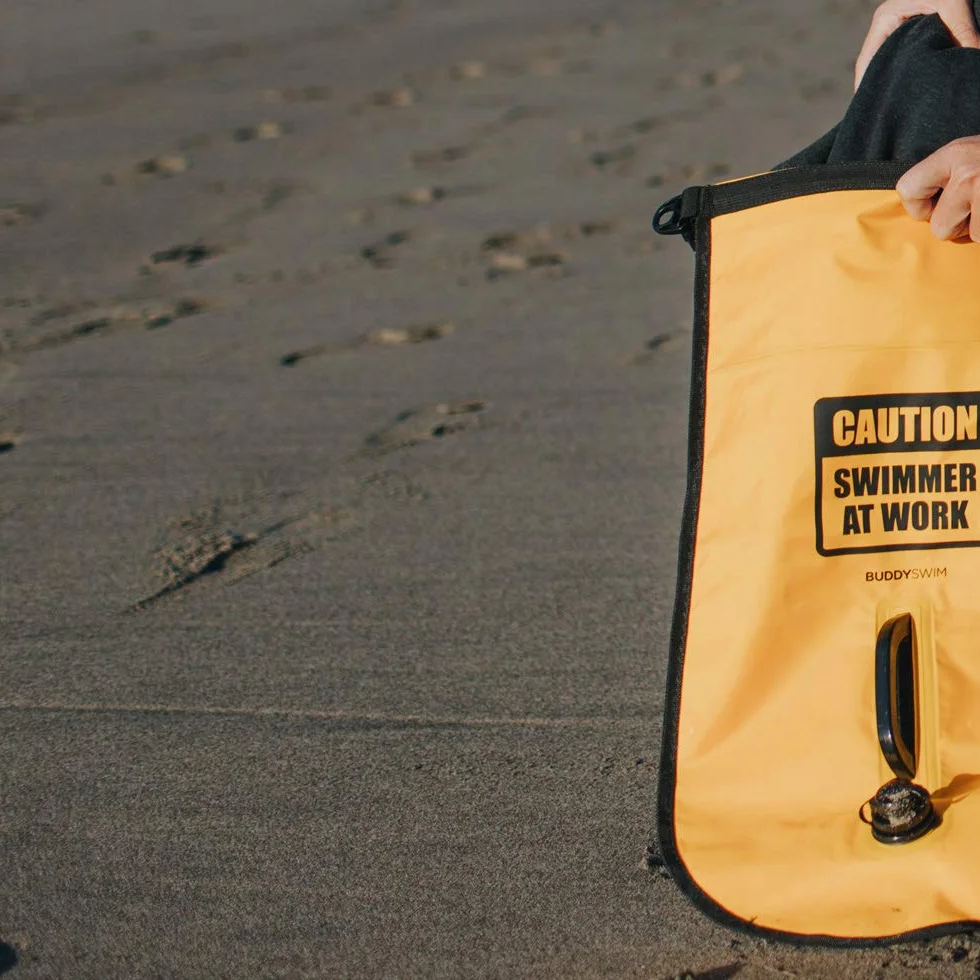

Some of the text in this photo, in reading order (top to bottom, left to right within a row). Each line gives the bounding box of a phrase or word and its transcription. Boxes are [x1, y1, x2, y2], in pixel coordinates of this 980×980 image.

[832, 405, 978, 447] CAUTION
[834, 463, 977, 498] SWIMMER
[843, 500, 969, 535] AT WORK
[865, 568, 947, 582] BUDDYSWIM
